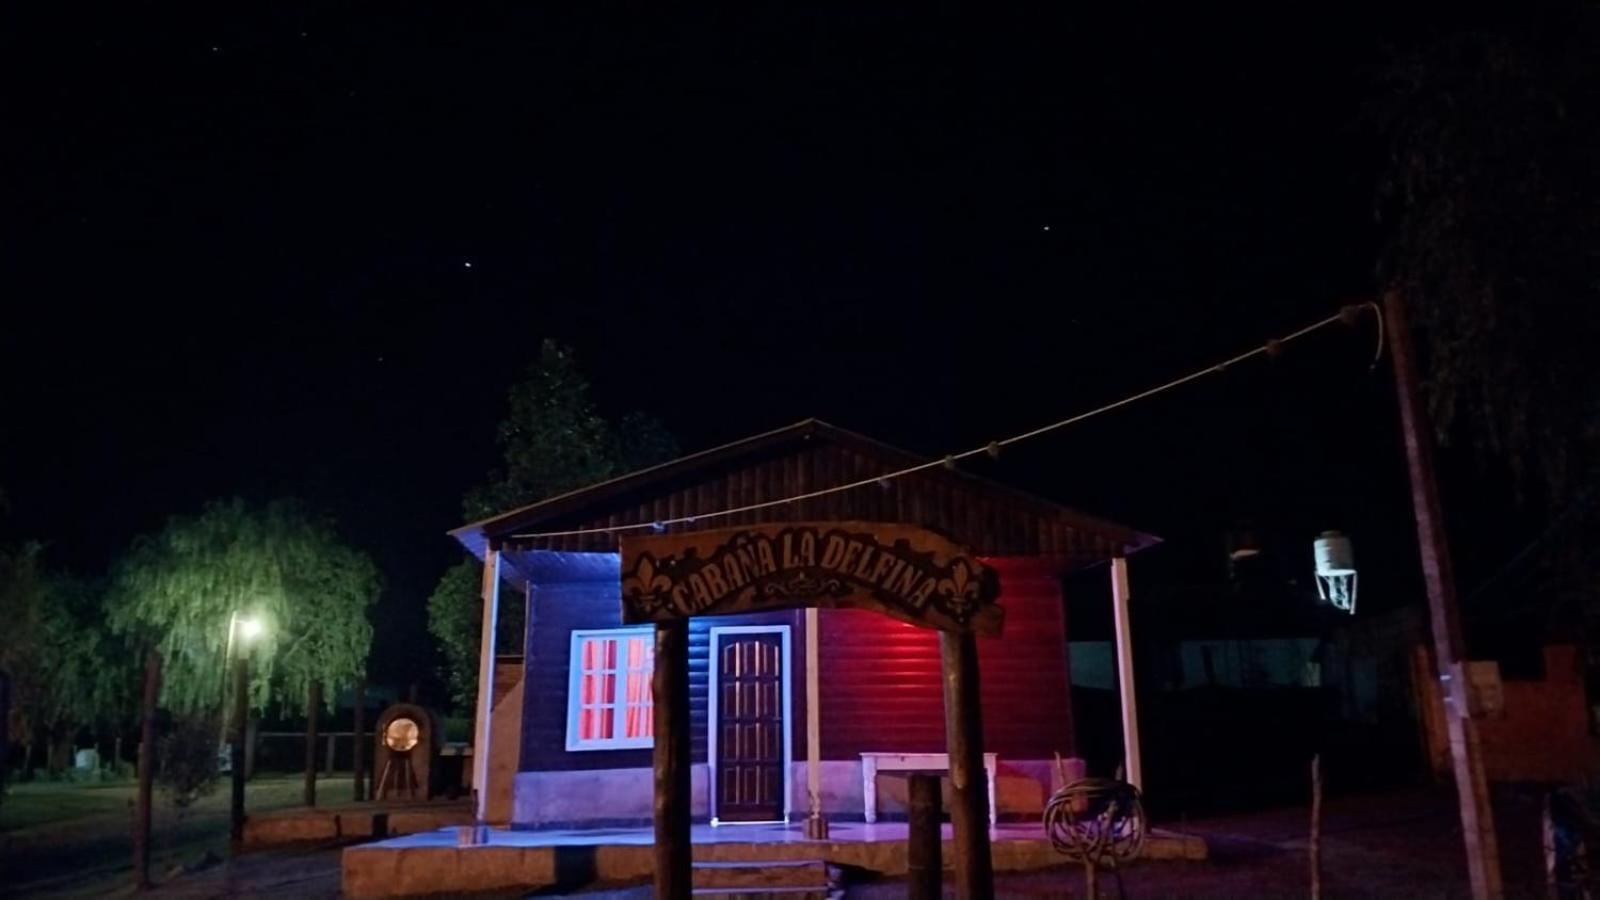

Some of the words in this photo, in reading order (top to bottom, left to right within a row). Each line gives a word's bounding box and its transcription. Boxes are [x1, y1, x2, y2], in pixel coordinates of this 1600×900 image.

[672, 536, 776, 615] CABAÑA
[783, 530, 816, 570] LA
[820, 534, 937, 609] DELFINA
